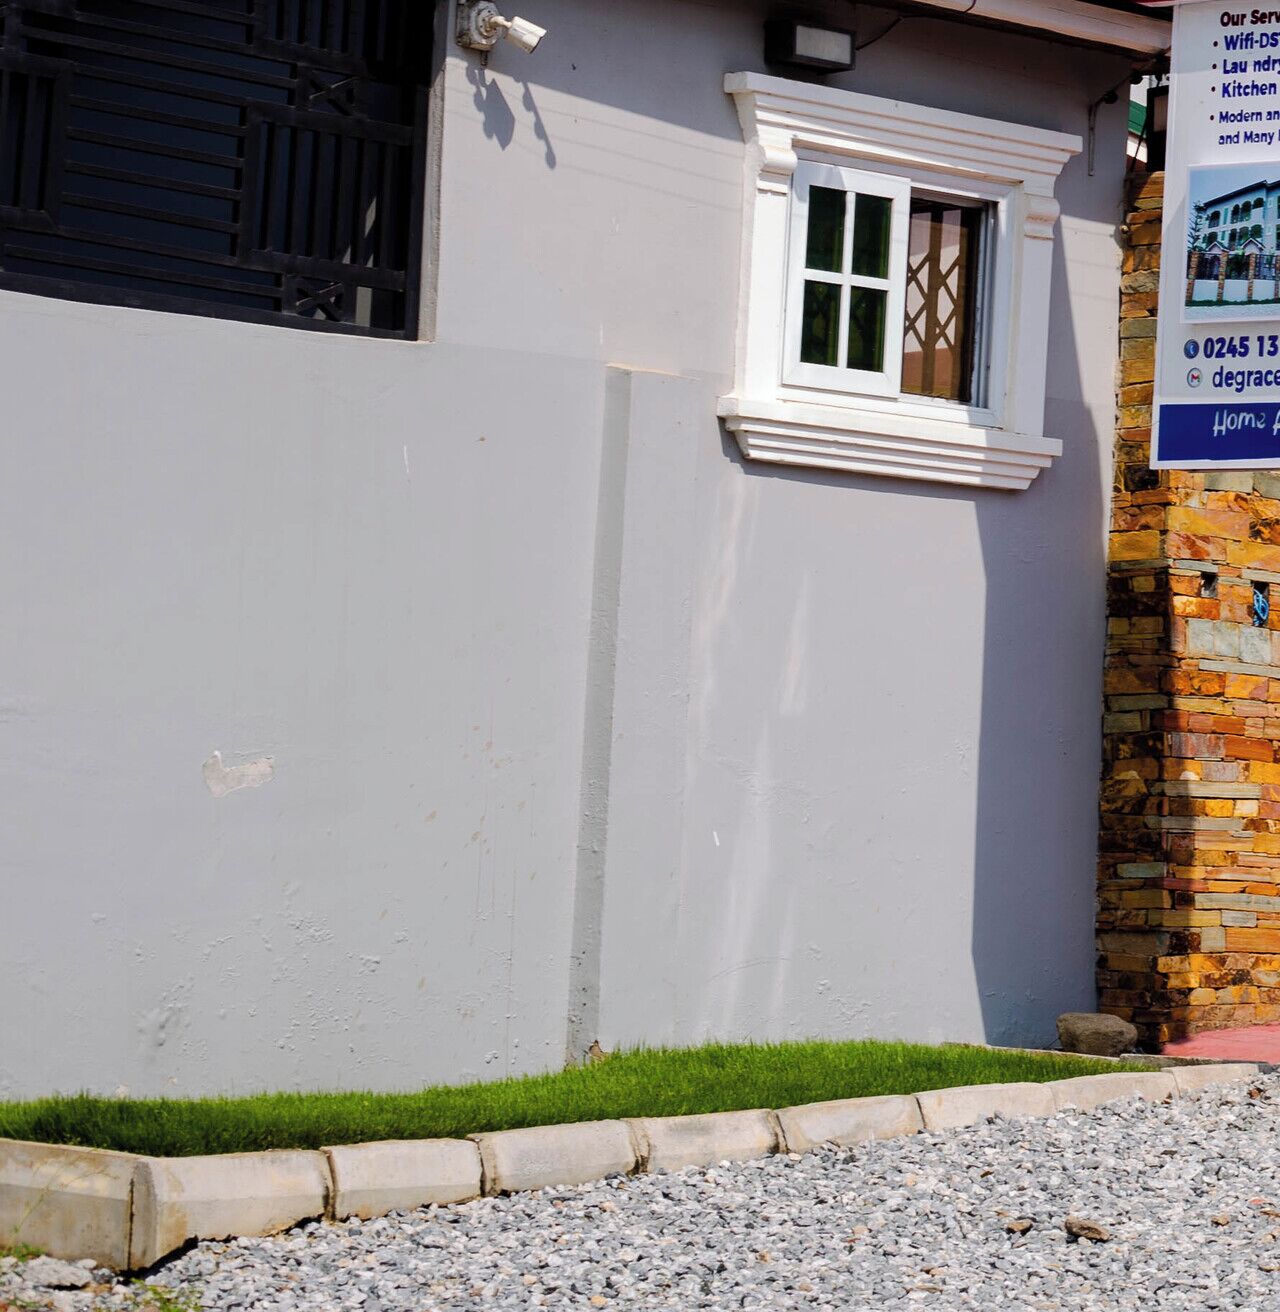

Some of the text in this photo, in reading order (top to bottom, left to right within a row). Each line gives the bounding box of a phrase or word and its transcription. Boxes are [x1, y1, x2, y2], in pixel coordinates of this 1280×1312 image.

[1220, 11, 1247, 27] Our
[1222, 79, 1277, 98] Kitchen
[1219, 109, 1263, 124] Modern
[1218, 131, 1240, 145] and
[1243, 130, 1275, 145] Many
[1203, 336, 1250, 359] 0245
[1257, 334, 1278, 357] 13
[1213, 408, 1266, 437] Home
